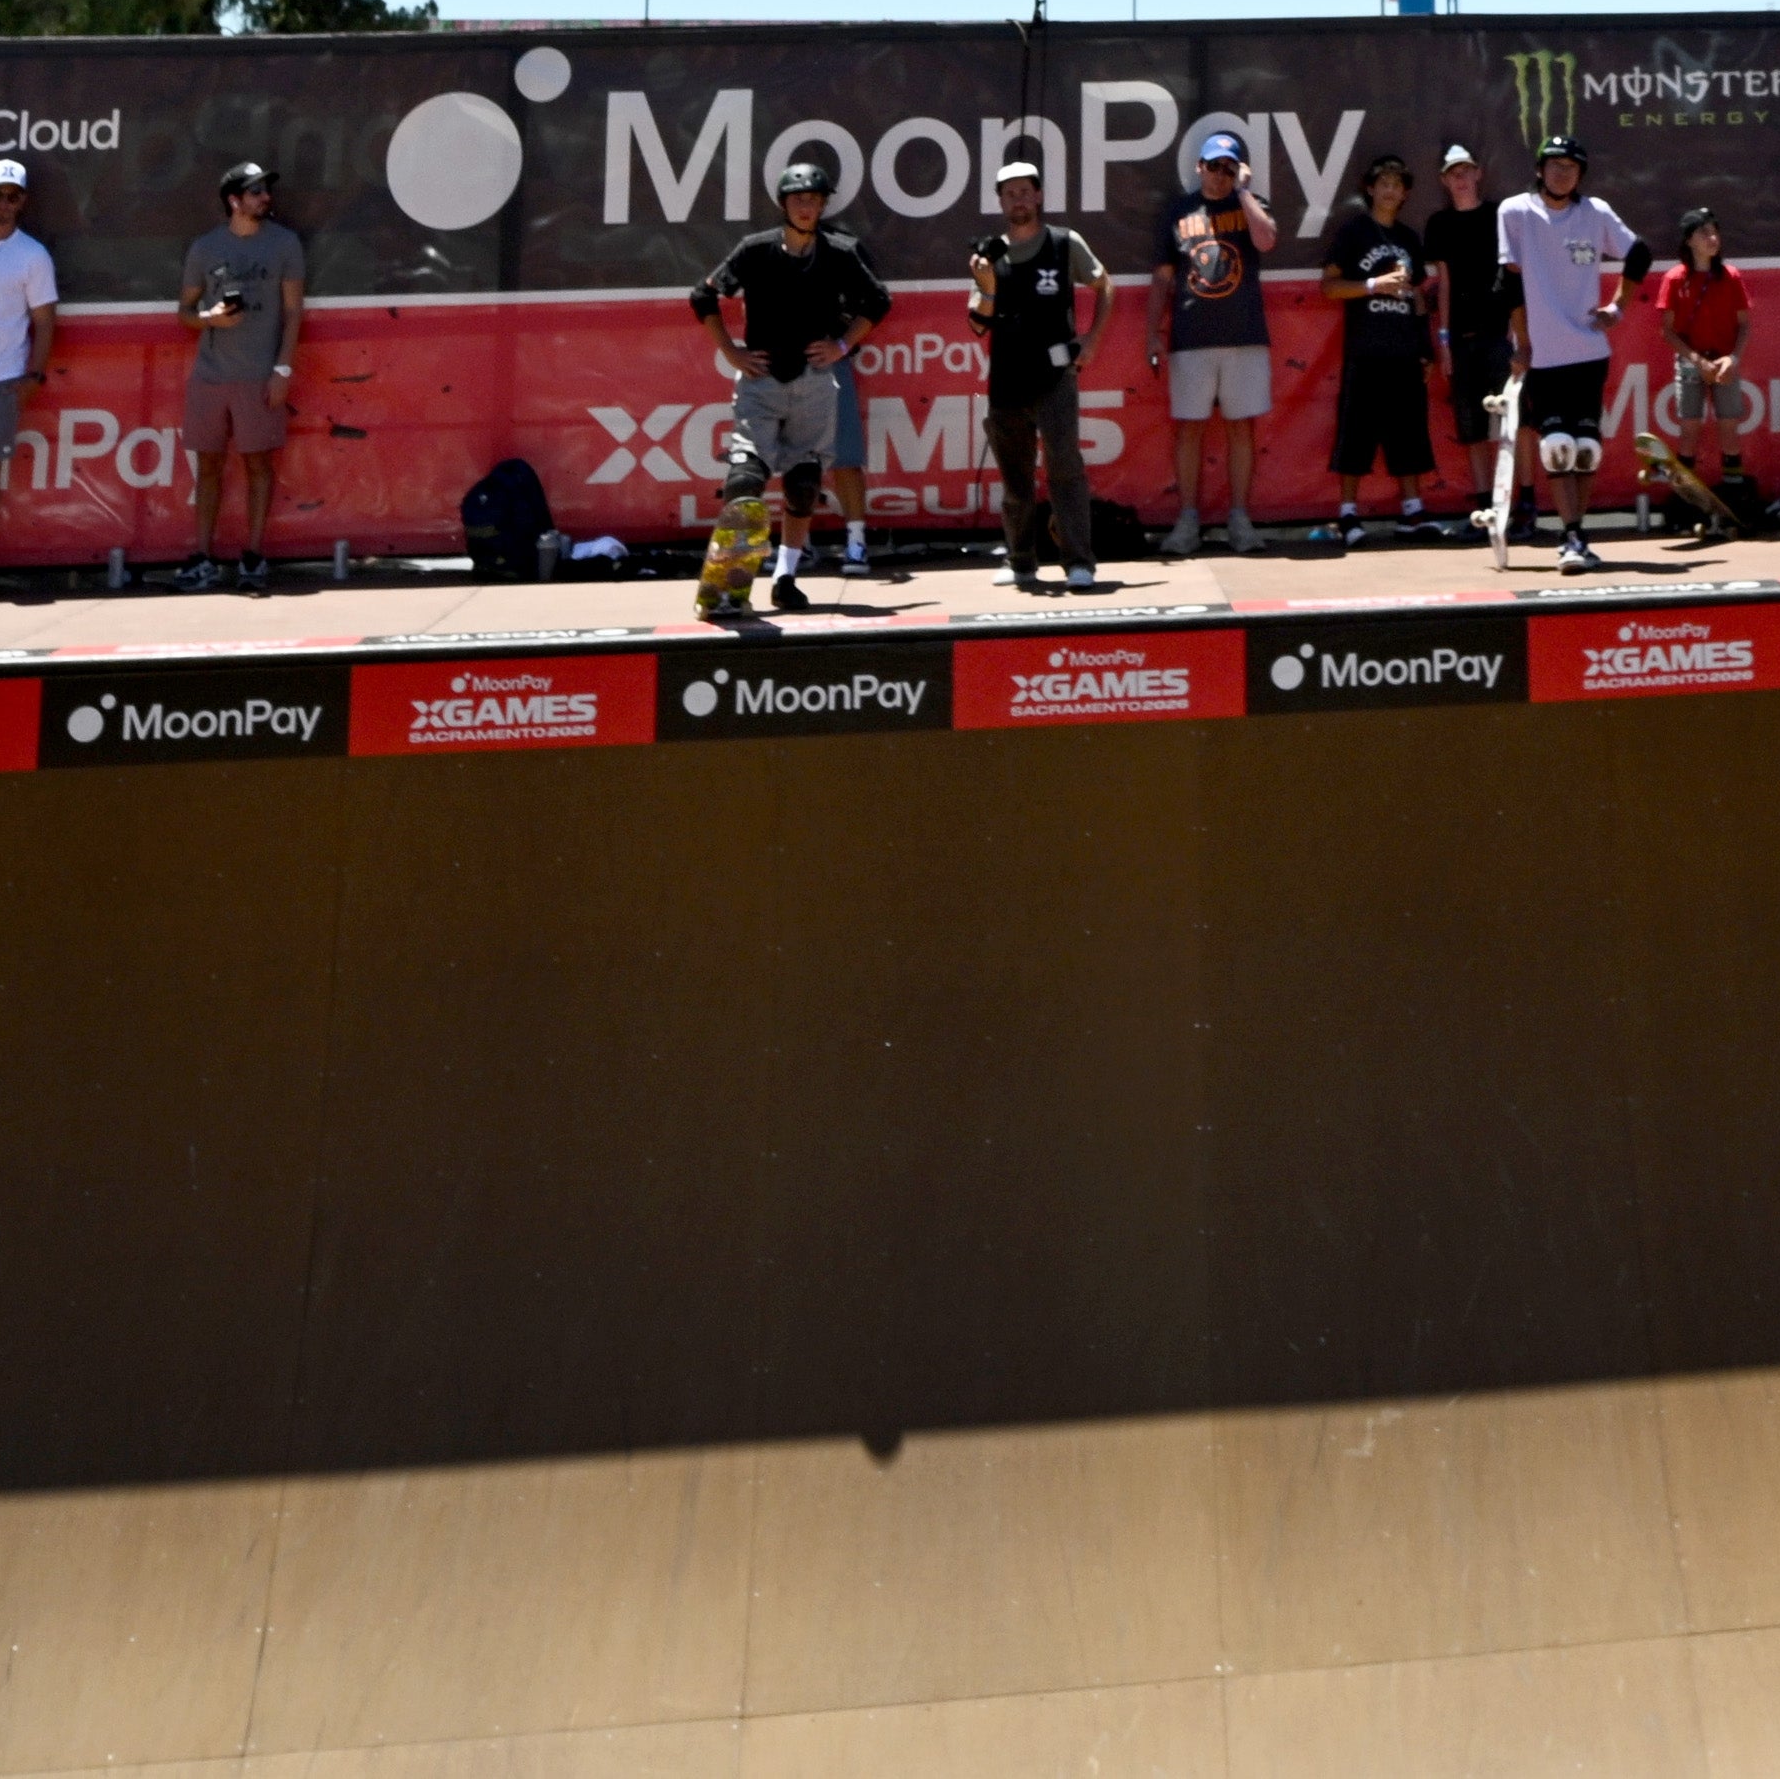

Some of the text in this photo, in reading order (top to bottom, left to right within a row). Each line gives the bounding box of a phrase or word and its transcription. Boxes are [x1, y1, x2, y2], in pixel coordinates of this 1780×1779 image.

[1619, 110, 1770, 127] ENERGY
[604, 79, 1366, 238] MoonPay
[1637, 623, 1710, 640] MoonPay
[1070, 649, 1146, 667] MoonPay
[1321, 645, 1503, 690] MoonPay
[473, 674, 552, 692] MoonPay
[735, 672, 926, 717] MoonPay
[122, 696, 323, 742] MoonPay
